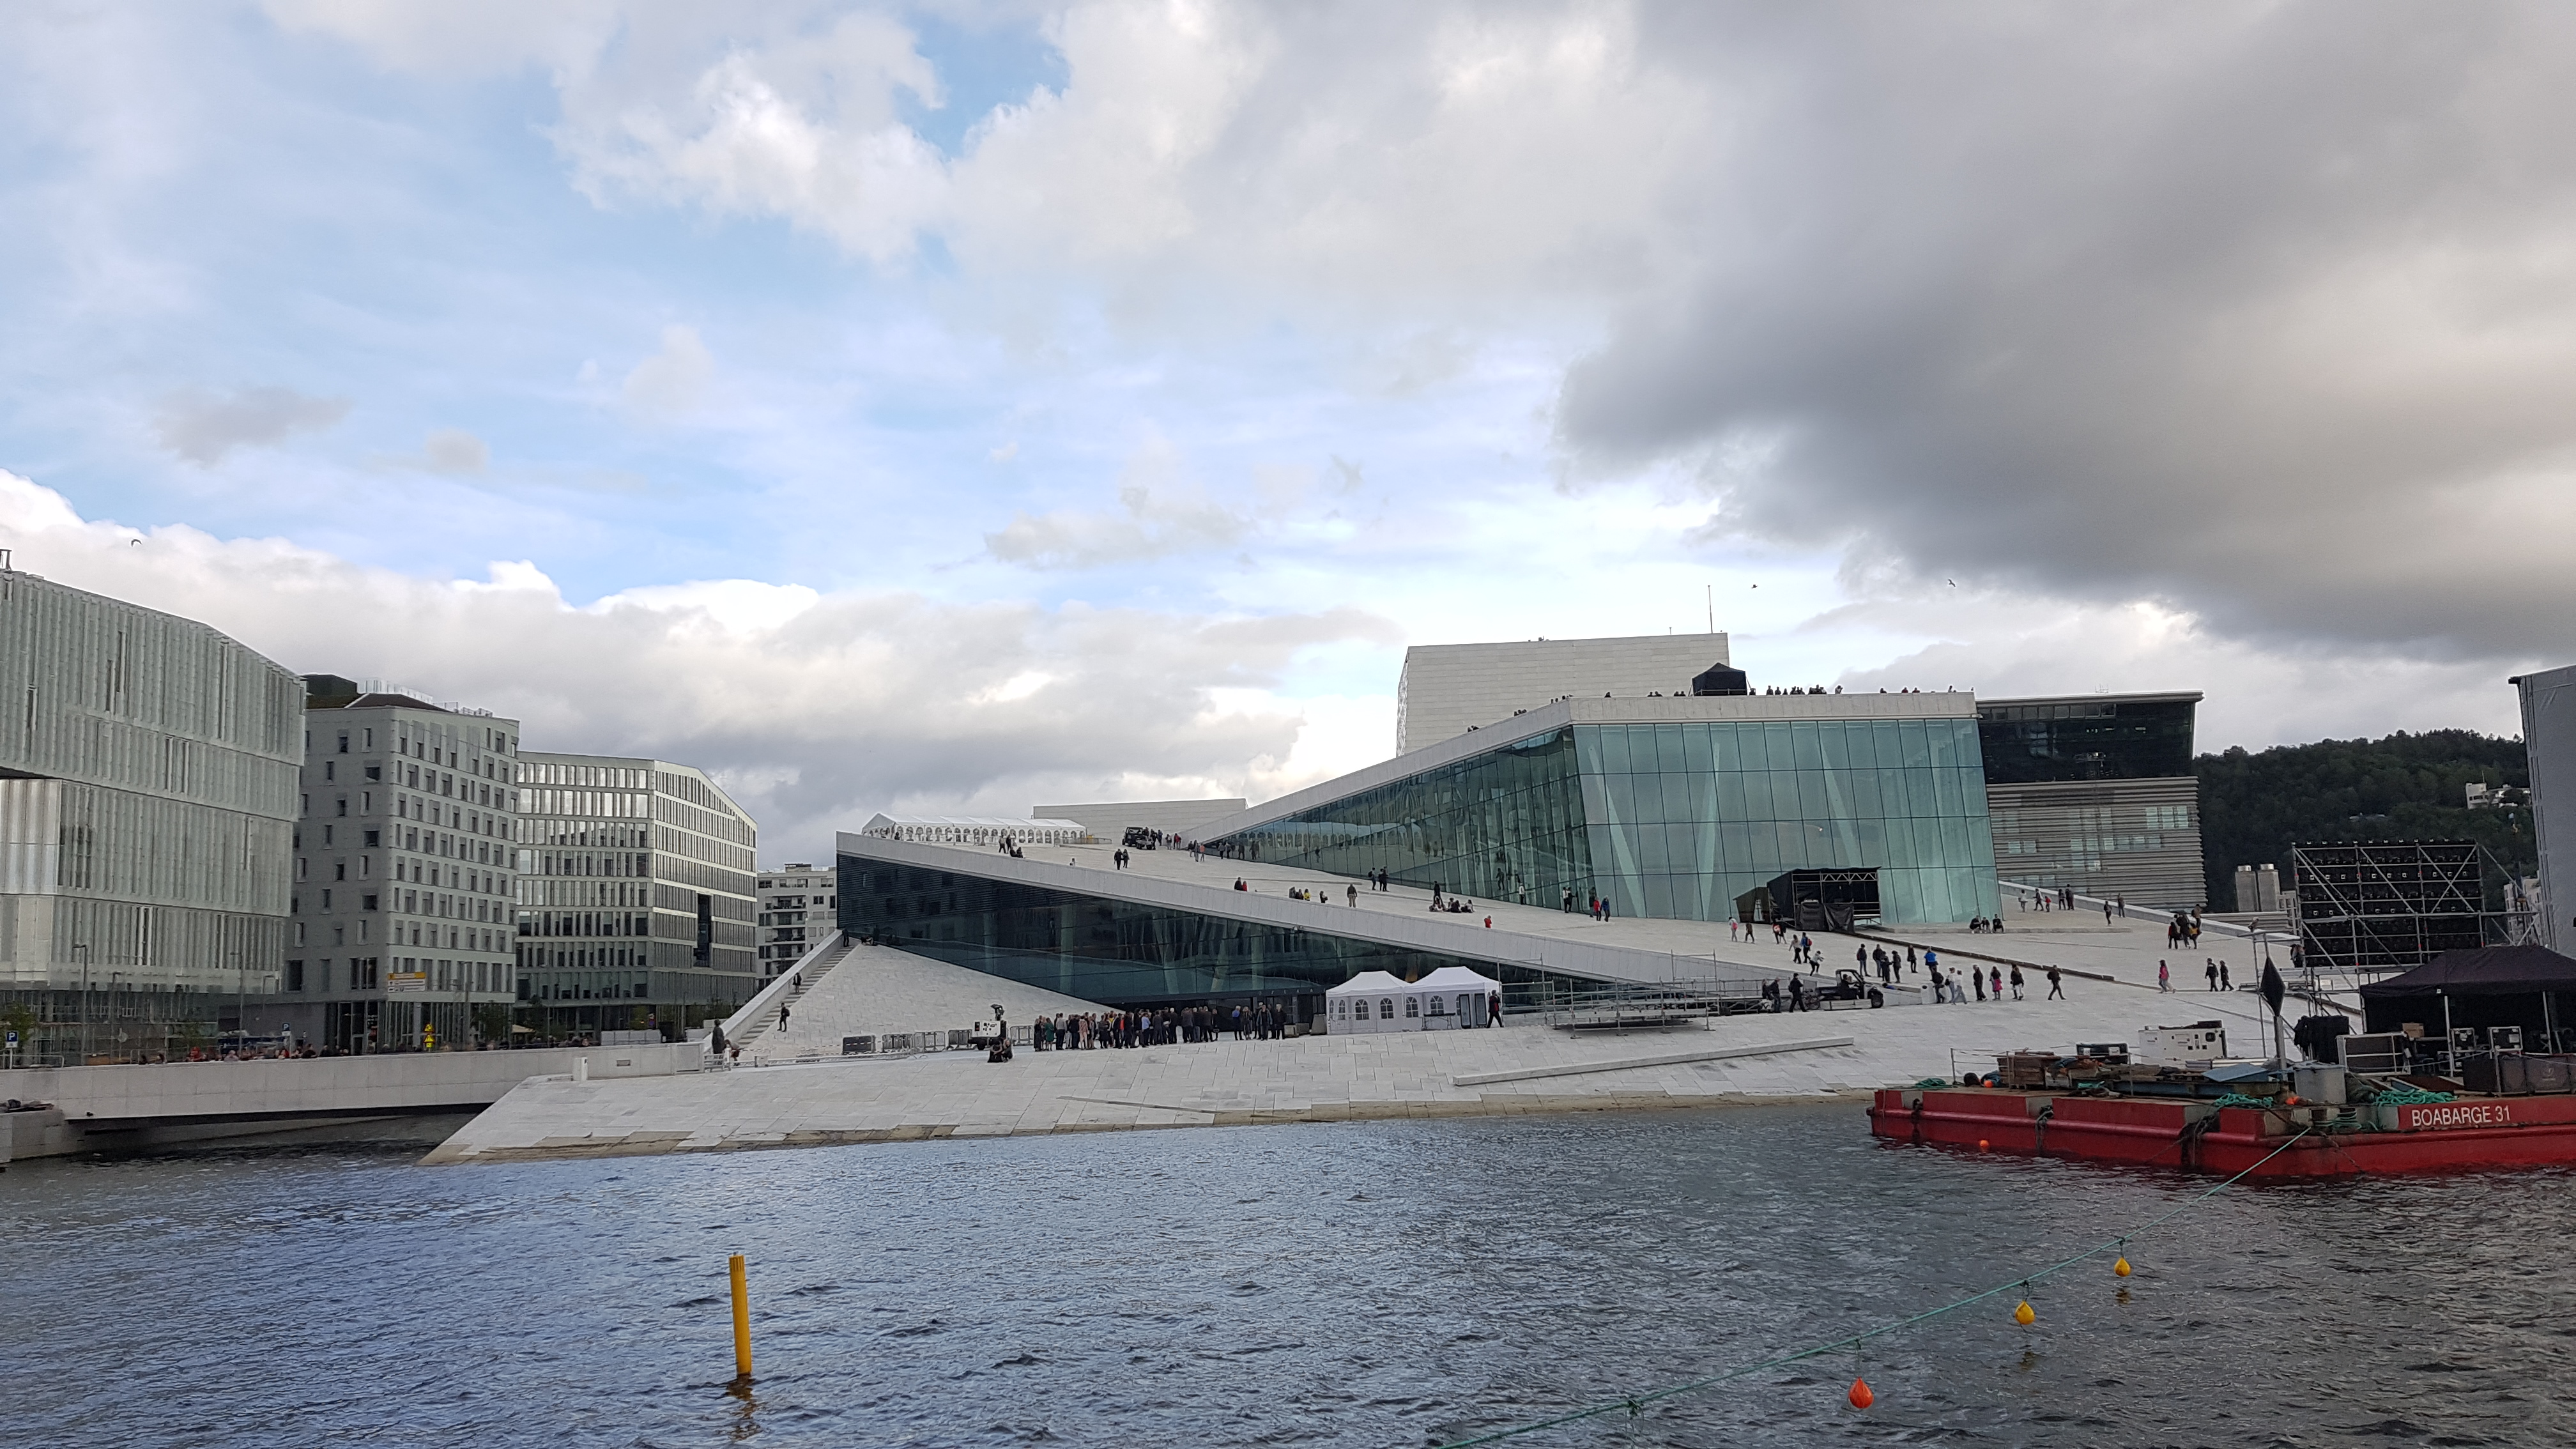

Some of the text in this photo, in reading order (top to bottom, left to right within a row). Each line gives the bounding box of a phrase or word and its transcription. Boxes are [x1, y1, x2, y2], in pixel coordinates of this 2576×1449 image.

[8, 1032, 16, 1041] P
[2412, 1105, 2510, 1126] BOABARGE 31
